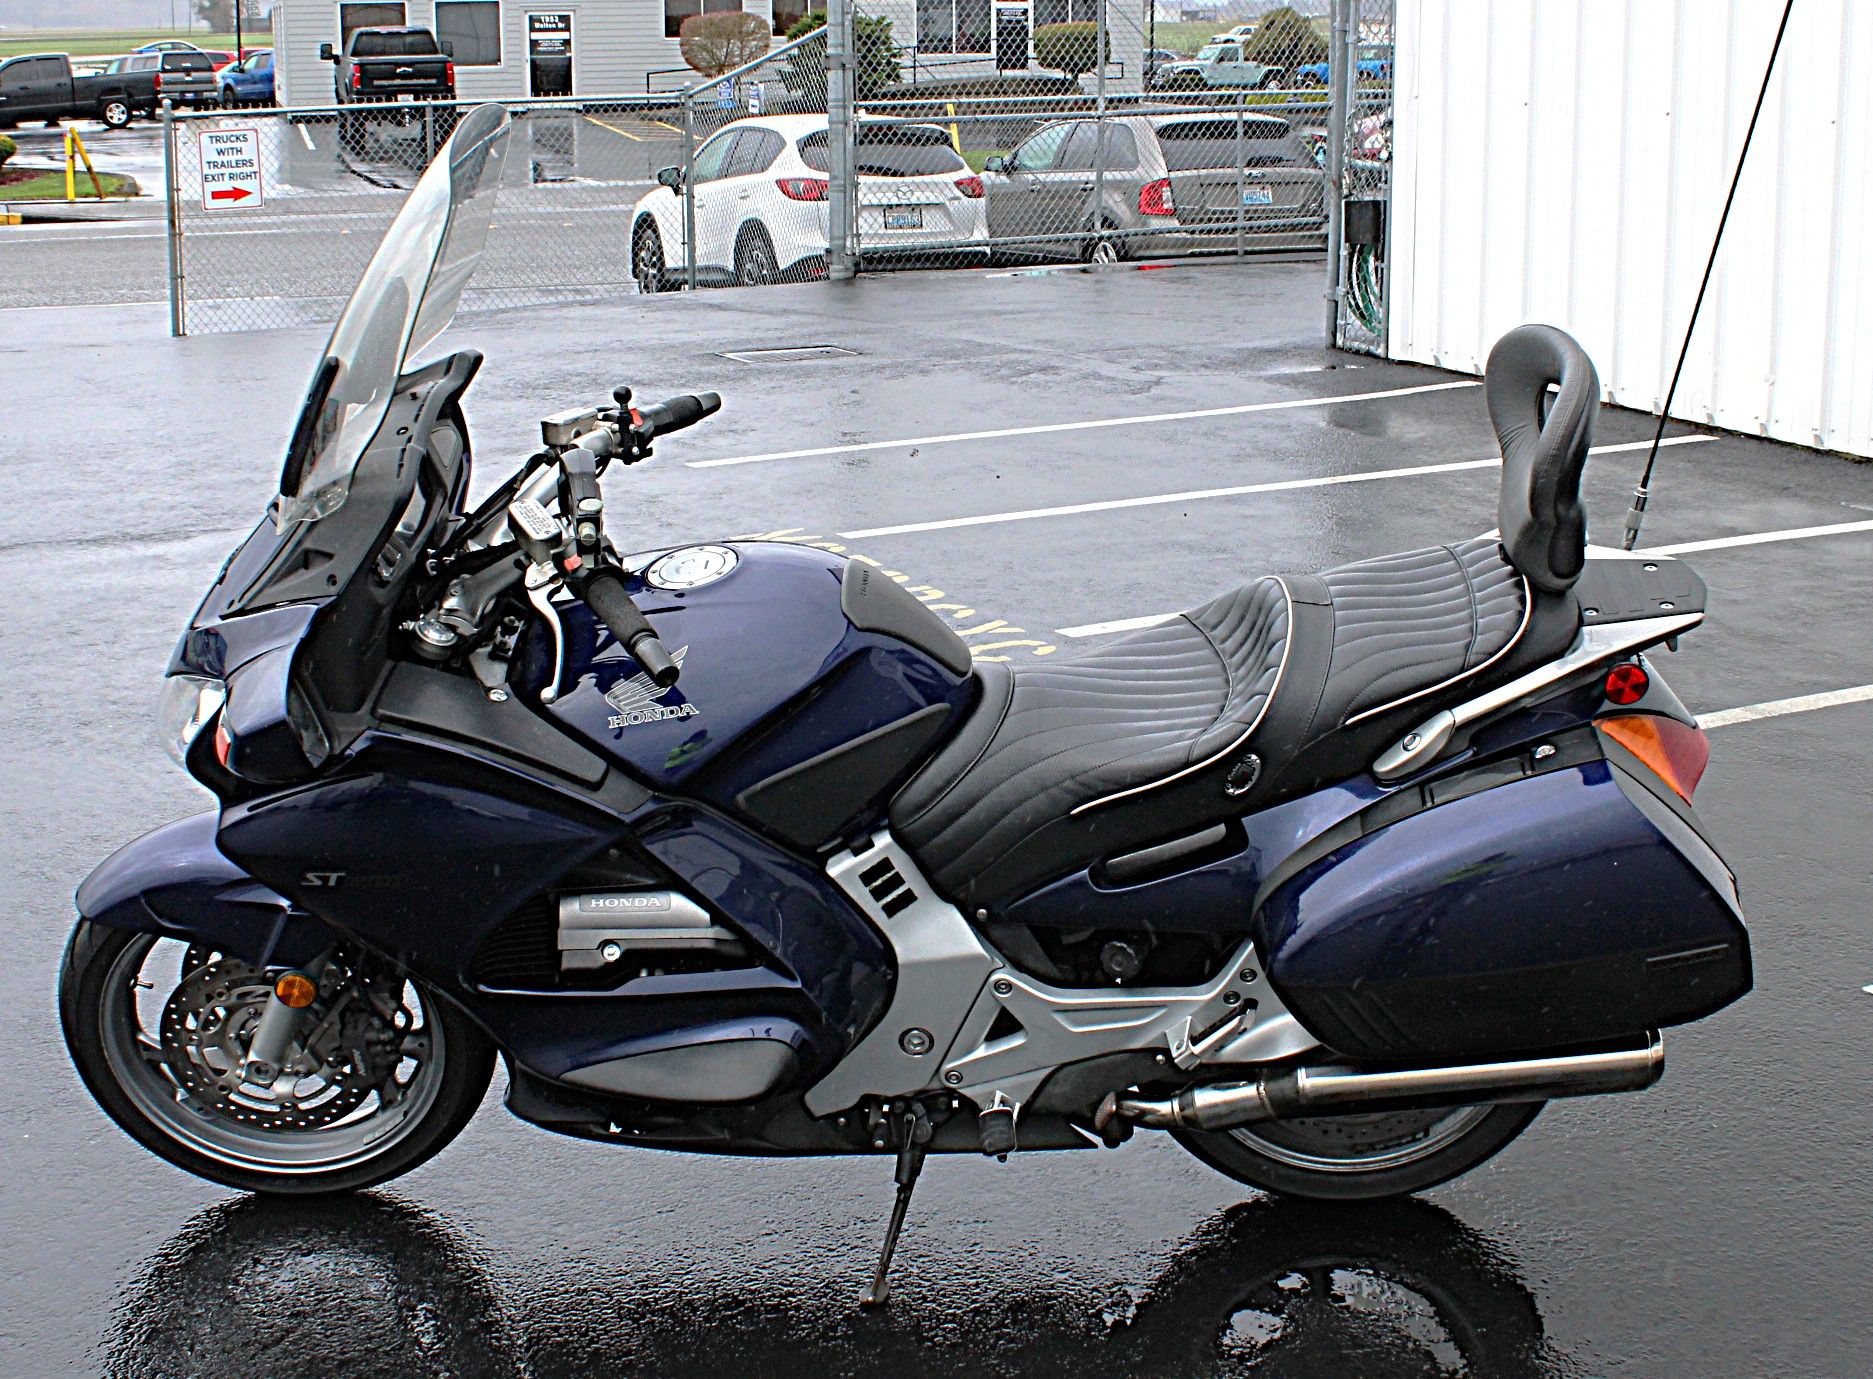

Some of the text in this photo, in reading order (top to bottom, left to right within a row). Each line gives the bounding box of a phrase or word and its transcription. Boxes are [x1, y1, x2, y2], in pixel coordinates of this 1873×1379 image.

[208, 134, 249, 144] TRUCKS
[215, 147, 243, 157] WITH
[206, 159, 254, 170] TRAILERS
[204, 171, 258, 182] EXIT RIGHT
[607, 703, 700, 729] HONDA
[300, 872, 346, 887] ST
[590, 897, 662, 908] HONDA
